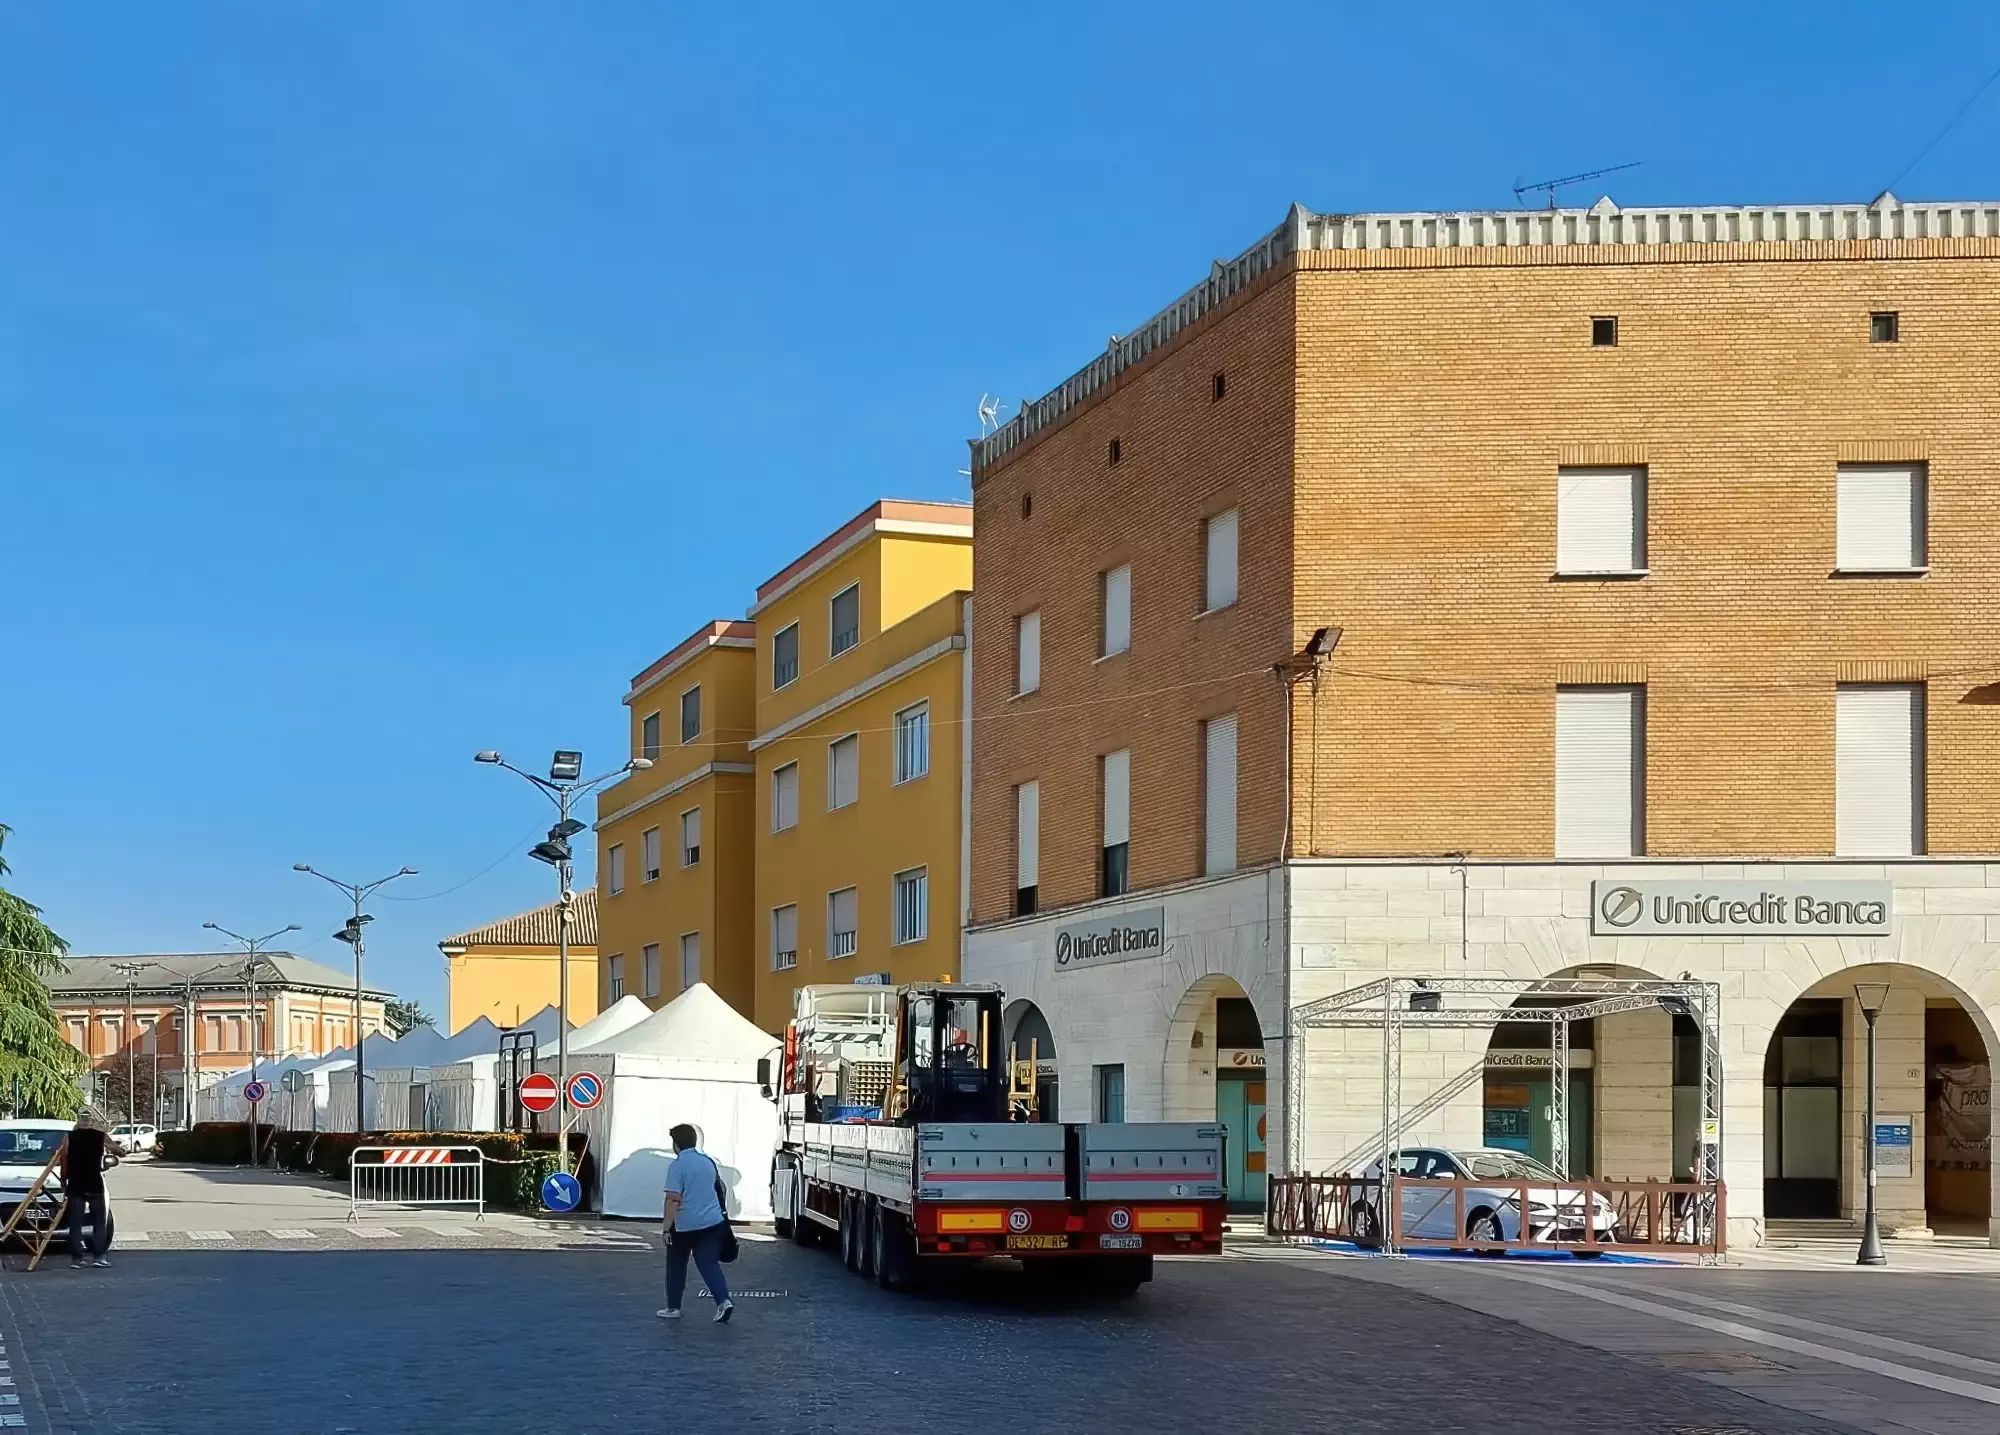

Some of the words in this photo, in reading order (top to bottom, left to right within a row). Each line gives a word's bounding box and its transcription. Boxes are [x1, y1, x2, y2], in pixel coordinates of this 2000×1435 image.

[1653, 892, 1788, 925] UniCredit
[1795, 895, 1886, 925] Banca
[1073, 927, 1122, 960] UniCredit
[1123, 927, 1159, 952] Banca
[1484, 1053, 1523, 1066] niCredit
[1525, 1054, 1553, 1066] Banc
[1014, 1213, 1026, 1225] 70
[1113, 1213, 1125, 1225] 80
